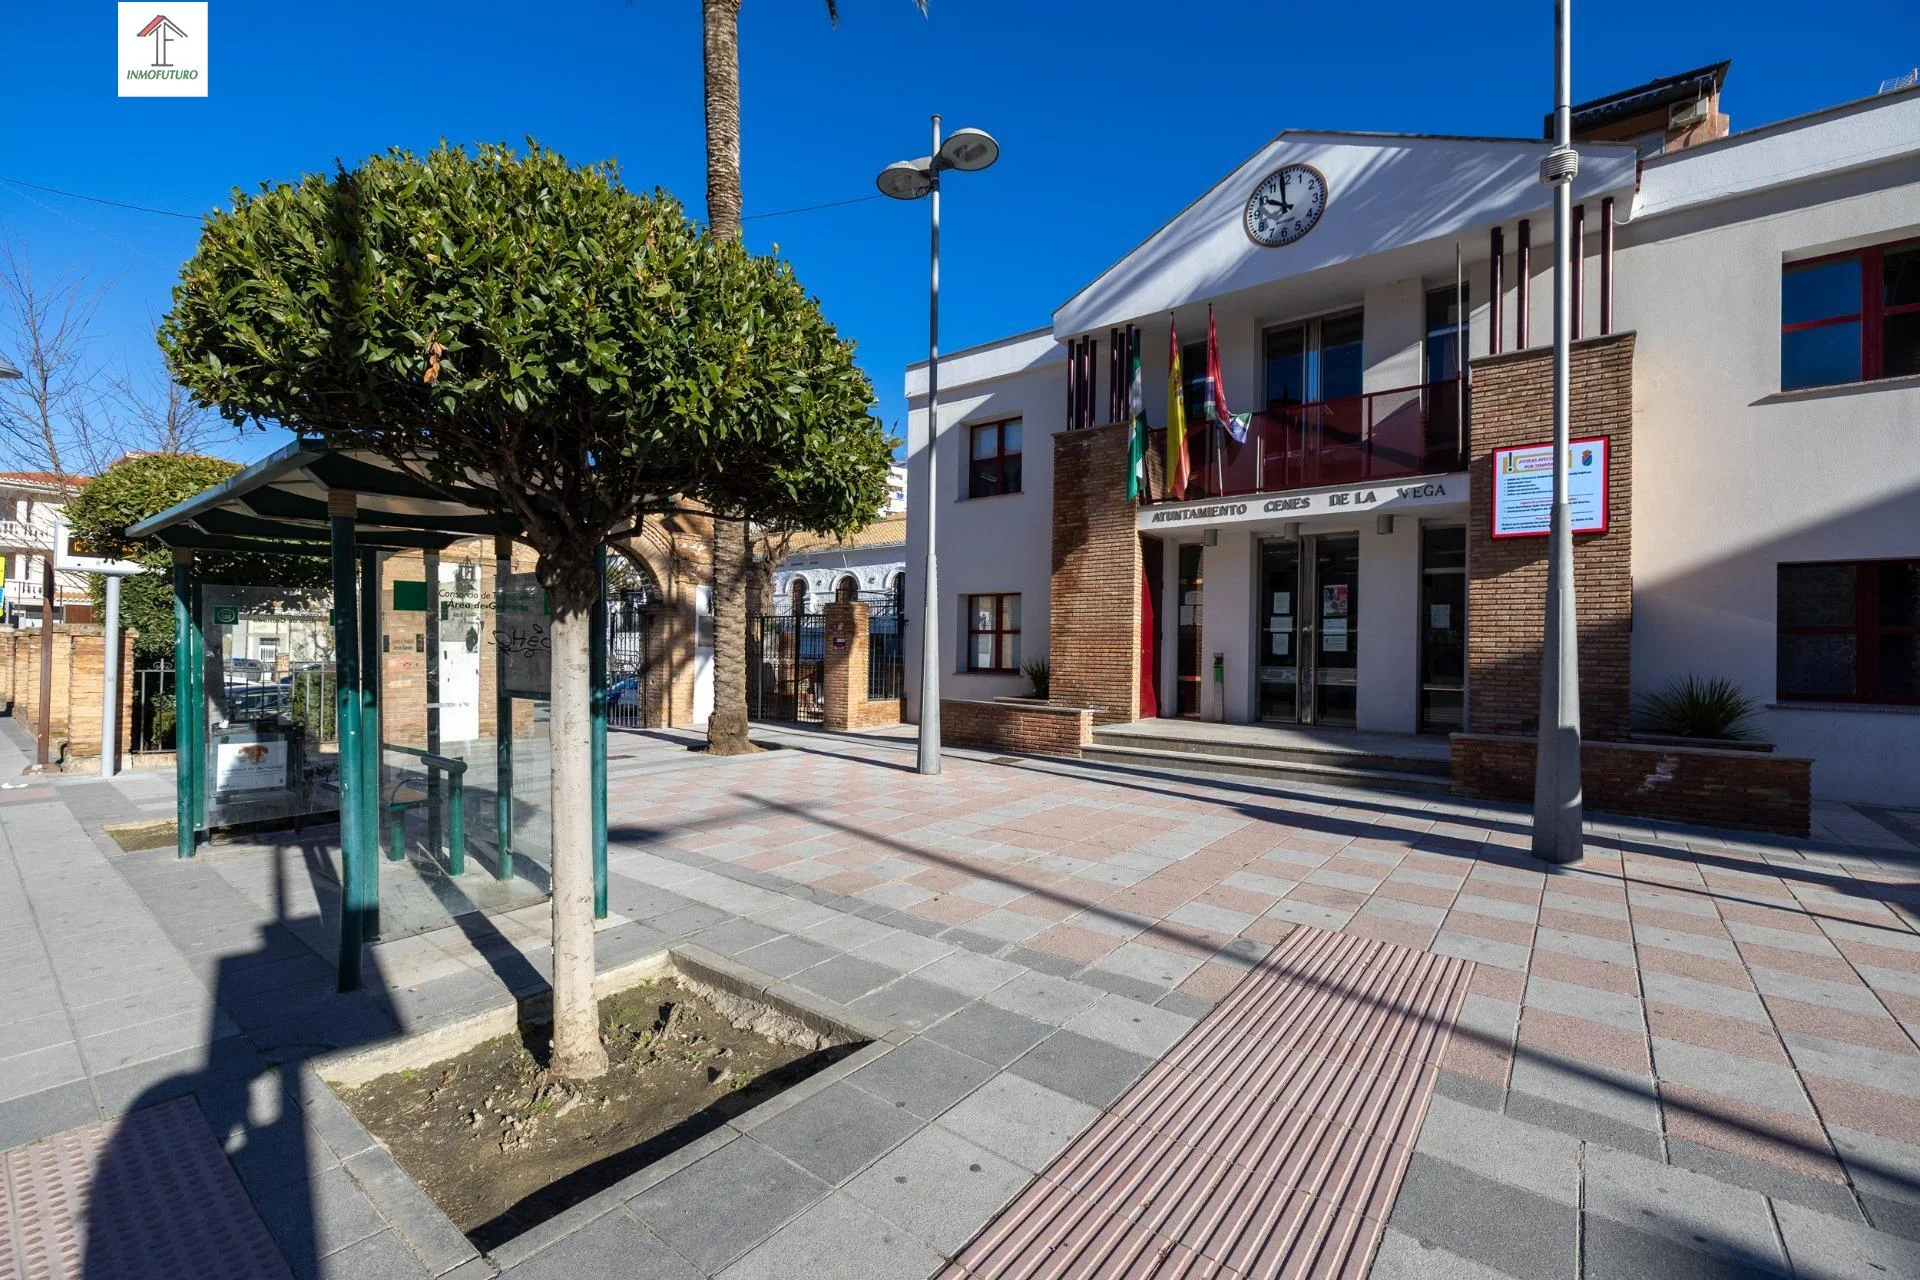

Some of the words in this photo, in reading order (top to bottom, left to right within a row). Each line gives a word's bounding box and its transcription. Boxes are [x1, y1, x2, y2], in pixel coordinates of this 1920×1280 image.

[1298, 173, 1302, 184] 1
[1269, 183, 1276, 194] 11
[1308, 180, 1315, 190] 2
[1312, 193, 1319, 203] 3
[1254, 210, 1260, 220] 9
[1306, 208, 1312, 218] 4
[1259, 222, 1265, 232] 8
[1295, 221, 1301, 231] 5
[1269, 228, 1275, 238] 7
[1281, 228, 1288, 237] 6
[1152, 504, 1247, 522] AYUNTAMIENTO
[1264, 497, 1311, 513] CENES
[1329, 493, 1349, 506] DE
[1354, 491, 1377, 504] LA
[1397, 484, 1446, 499] VEGA
[439, 588, 478, 600] Consorcio
[481, 592, 491, 600] de
[473, 601, 488, 609] de
